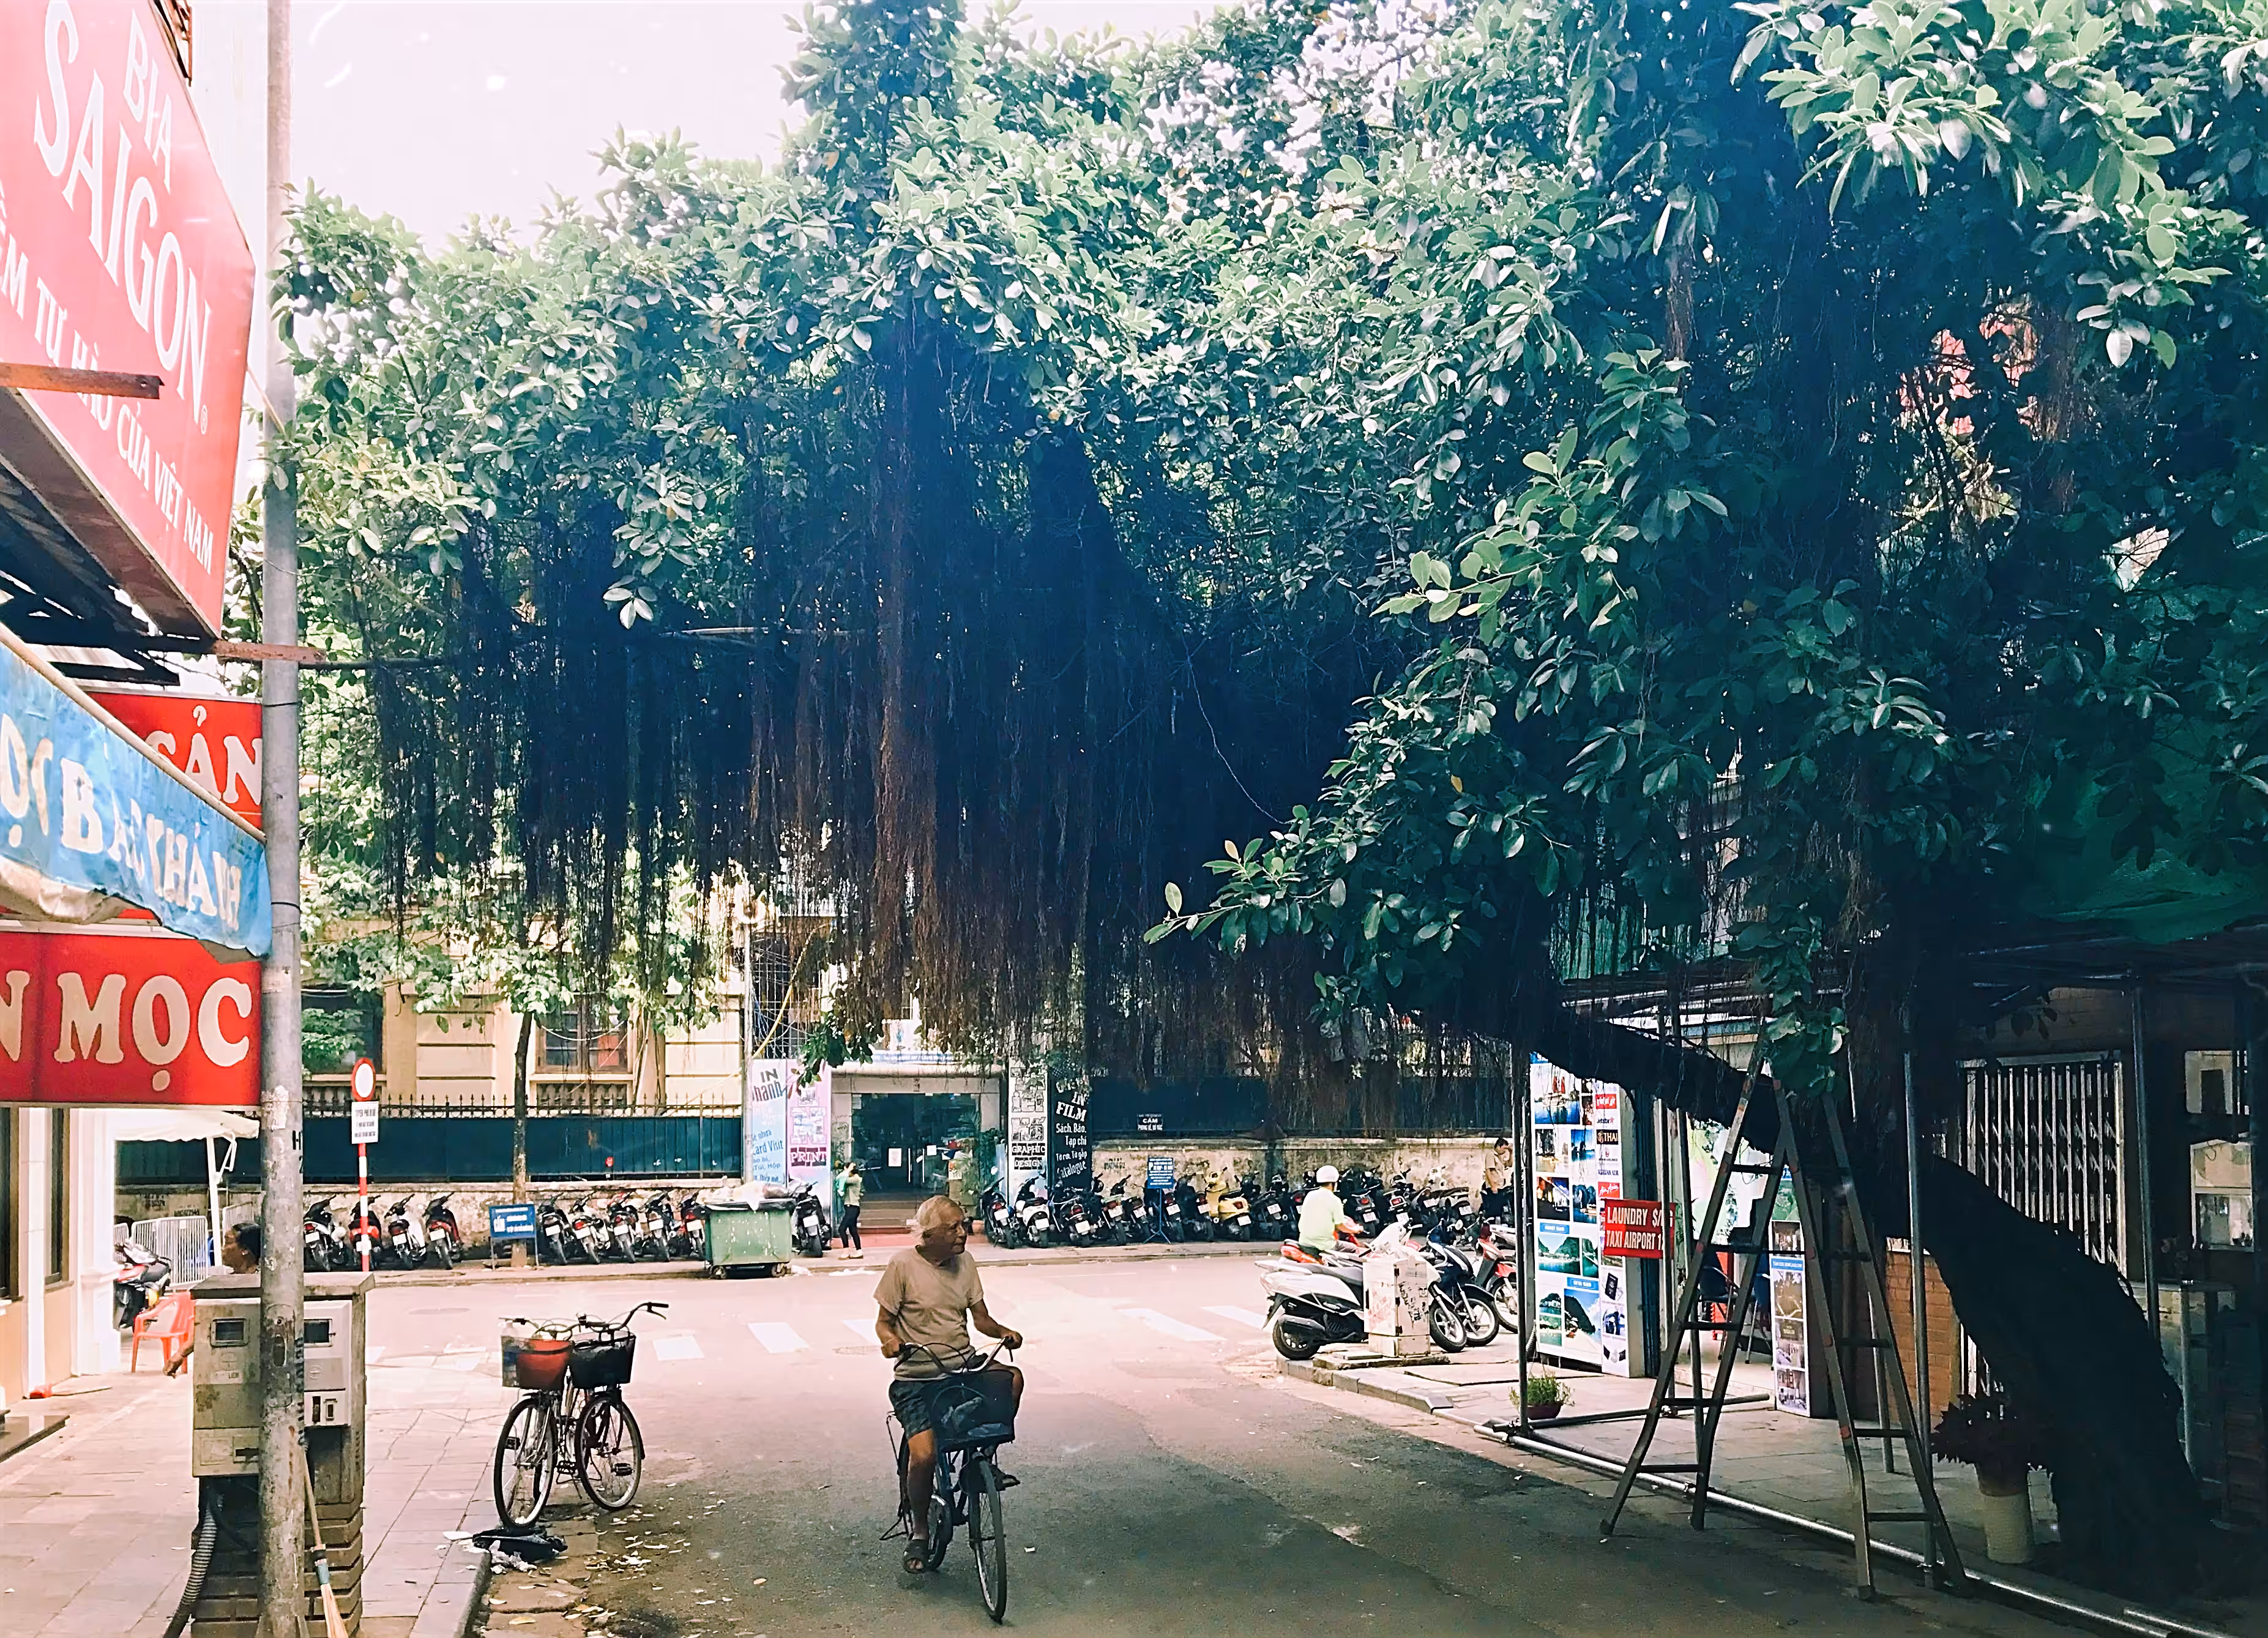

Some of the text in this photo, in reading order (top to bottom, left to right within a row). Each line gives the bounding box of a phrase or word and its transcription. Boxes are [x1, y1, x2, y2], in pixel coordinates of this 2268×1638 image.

[124, 9, 173, 195] BIA
[34, 0, 211, 424] SAIGON
[117, 402, 150, 491] CỦA
[154, 451, 183, 531] VIỆT
[184, 498, 213, 575] NAM
[53, 971, 252, 1091] MỌC
[760, 1068, 778, 1083] IN
[1056, 1101, 1087, 1122] FILM
[768, 1140, 783, 1151] Visit
[1065, 1135, 1087, 1148] Tạp chí
[1603, 1132, 1618, 1142] THAI
[790, 1151, 827, 1163] PRINT
[1607, 1206, 1647, 1225] LAUNDRY
[1606, 1230, 1622, 1247] TAXI
[1624, 1231, 1656, 1250] AIRPORT
